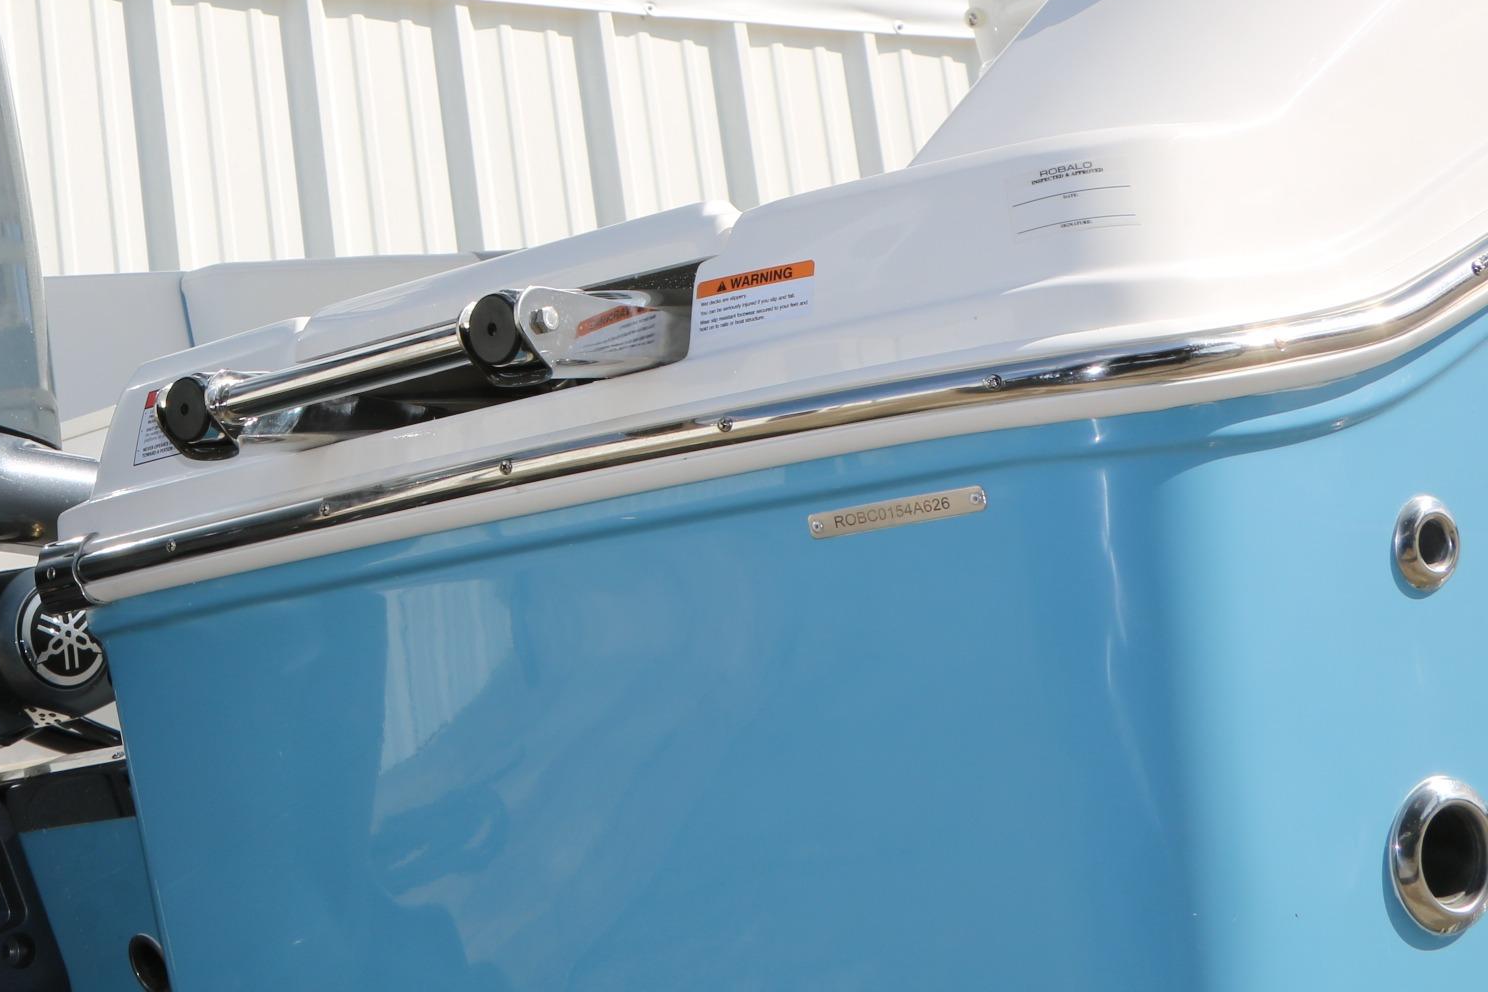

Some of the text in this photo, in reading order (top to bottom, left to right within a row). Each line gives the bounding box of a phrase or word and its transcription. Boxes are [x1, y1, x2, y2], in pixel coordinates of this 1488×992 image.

[1031, 174, 1064, 185] INSPECTED
[1071, 167, 1104, 176] APPROVED
[1039, 161, 1093, 177] ROBALO
[730, 267, 793, 289] WARNING
[834, 496, 950, 529] ROBC0154A626
